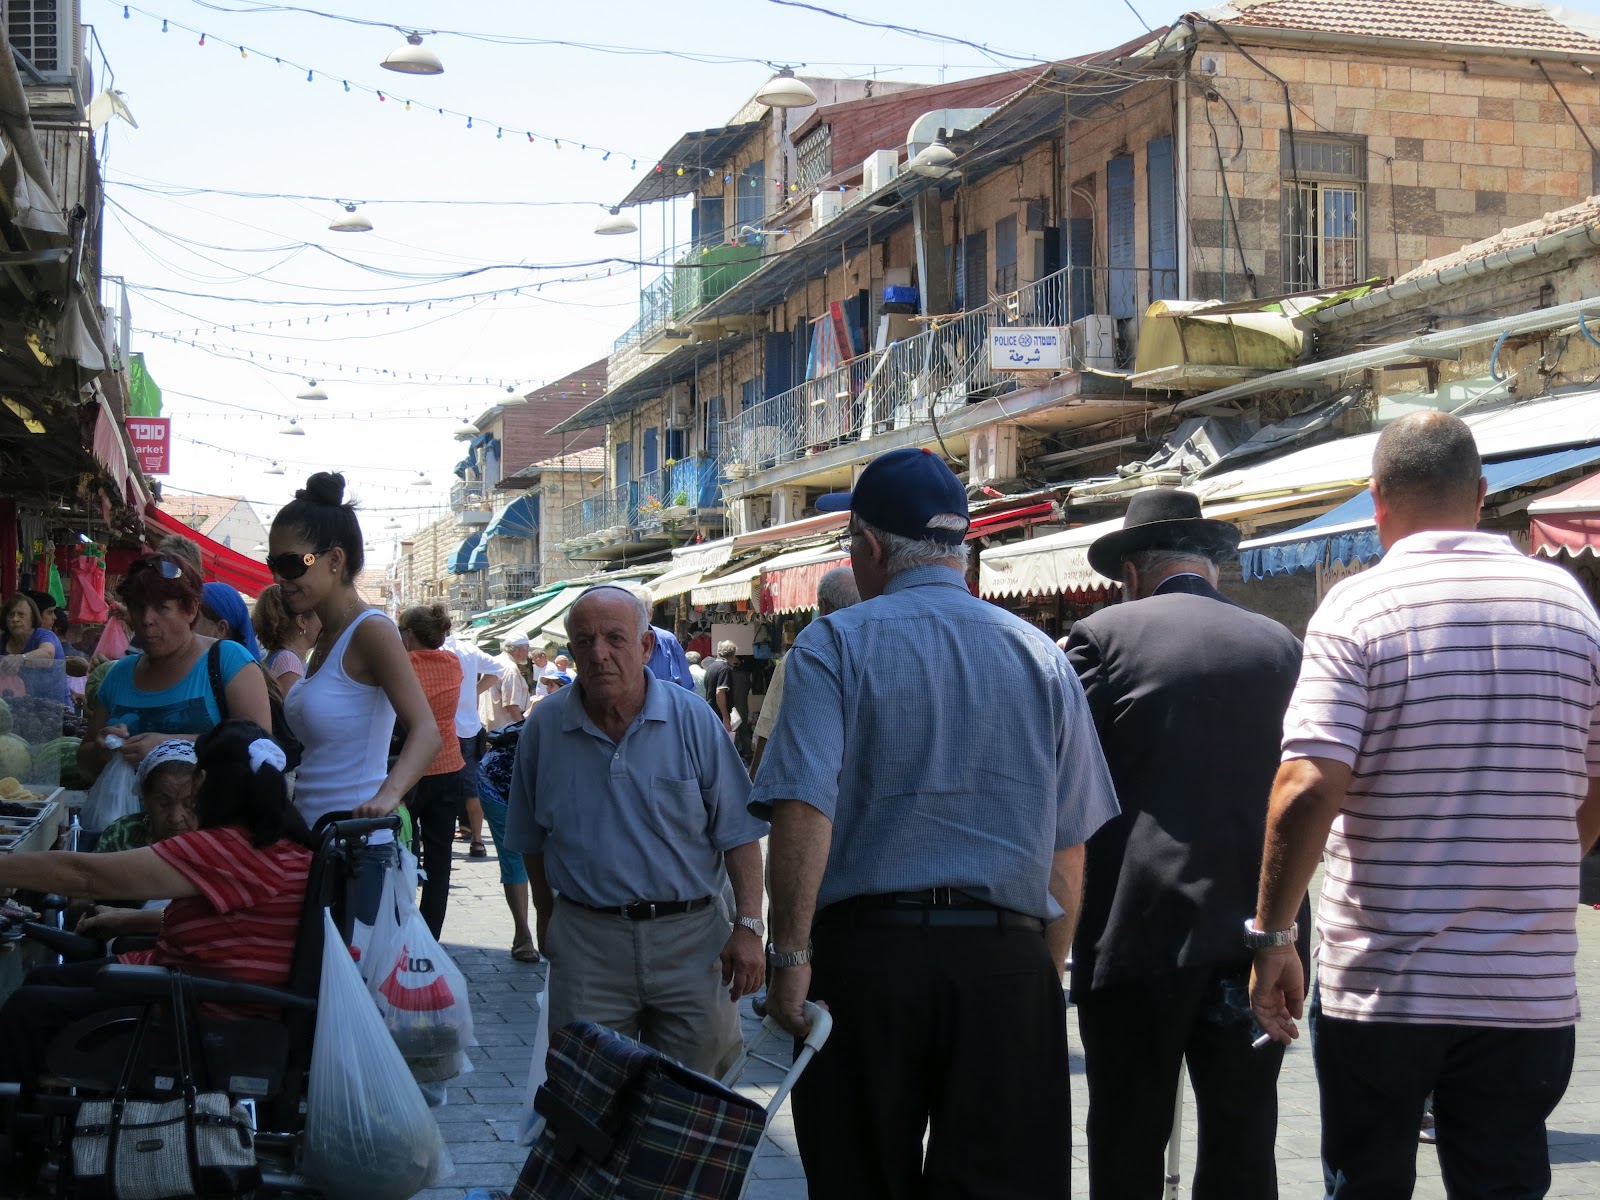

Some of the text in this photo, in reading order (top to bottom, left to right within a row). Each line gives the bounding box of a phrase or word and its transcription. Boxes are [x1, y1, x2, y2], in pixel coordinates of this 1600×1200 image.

[994, 335, 1017, 346] POLICE
[1033, 335, 1057, 346] משטרה
[1008, 348, 1041, 365] شرطة
[130, 424, 165, 441] סופר
